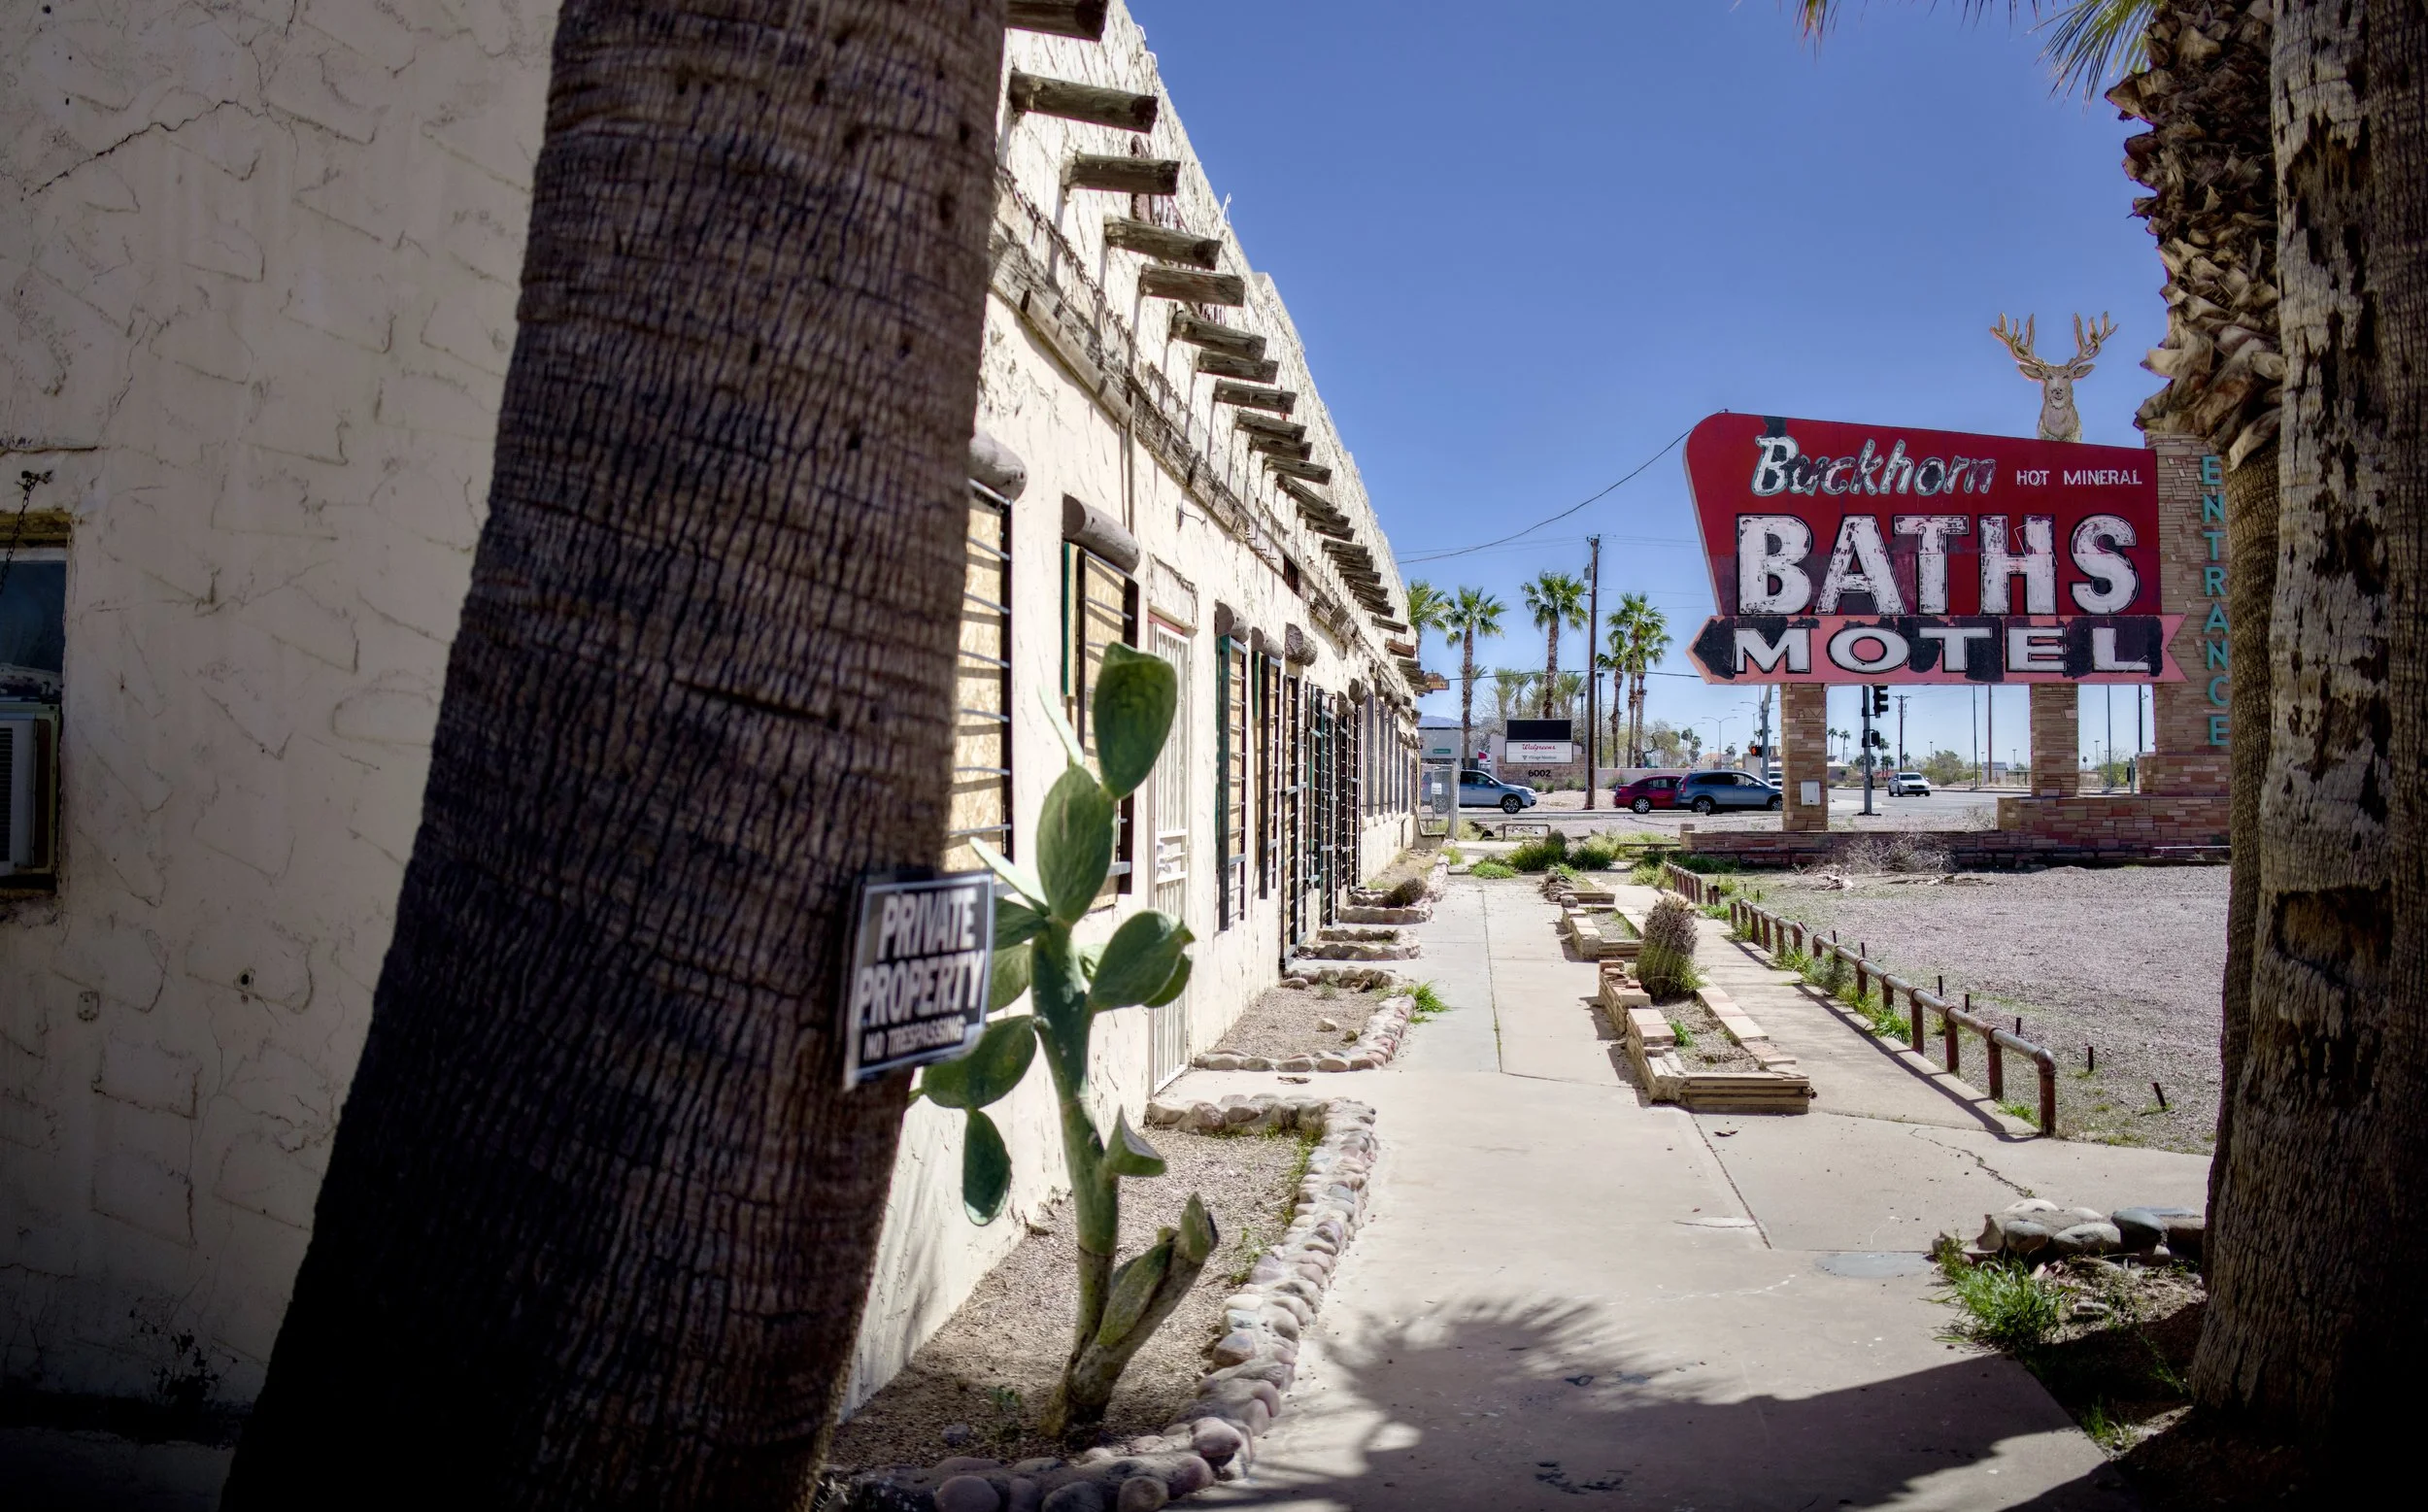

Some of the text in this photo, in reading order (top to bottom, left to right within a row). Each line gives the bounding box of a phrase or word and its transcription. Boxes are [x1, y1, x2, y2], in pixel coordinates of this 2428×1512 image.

[1750, 435, 1997, 497] Buckhorn
[2016, 469, 2142, 486] HOT MINERAL
[1737, 514, 2140, 617] BATHS
[2201, 454, 2231, 747] ENTRANCE
[1732, 626, 2152, 673] MOTEL
[1528, 769, 1551, 778] 6002
[876, 886, 978, 960] PRIVATE
[857, 950, 986, 1026] PROPERTY
[863, 1015, 967, 1060] NO TRESPASSING
